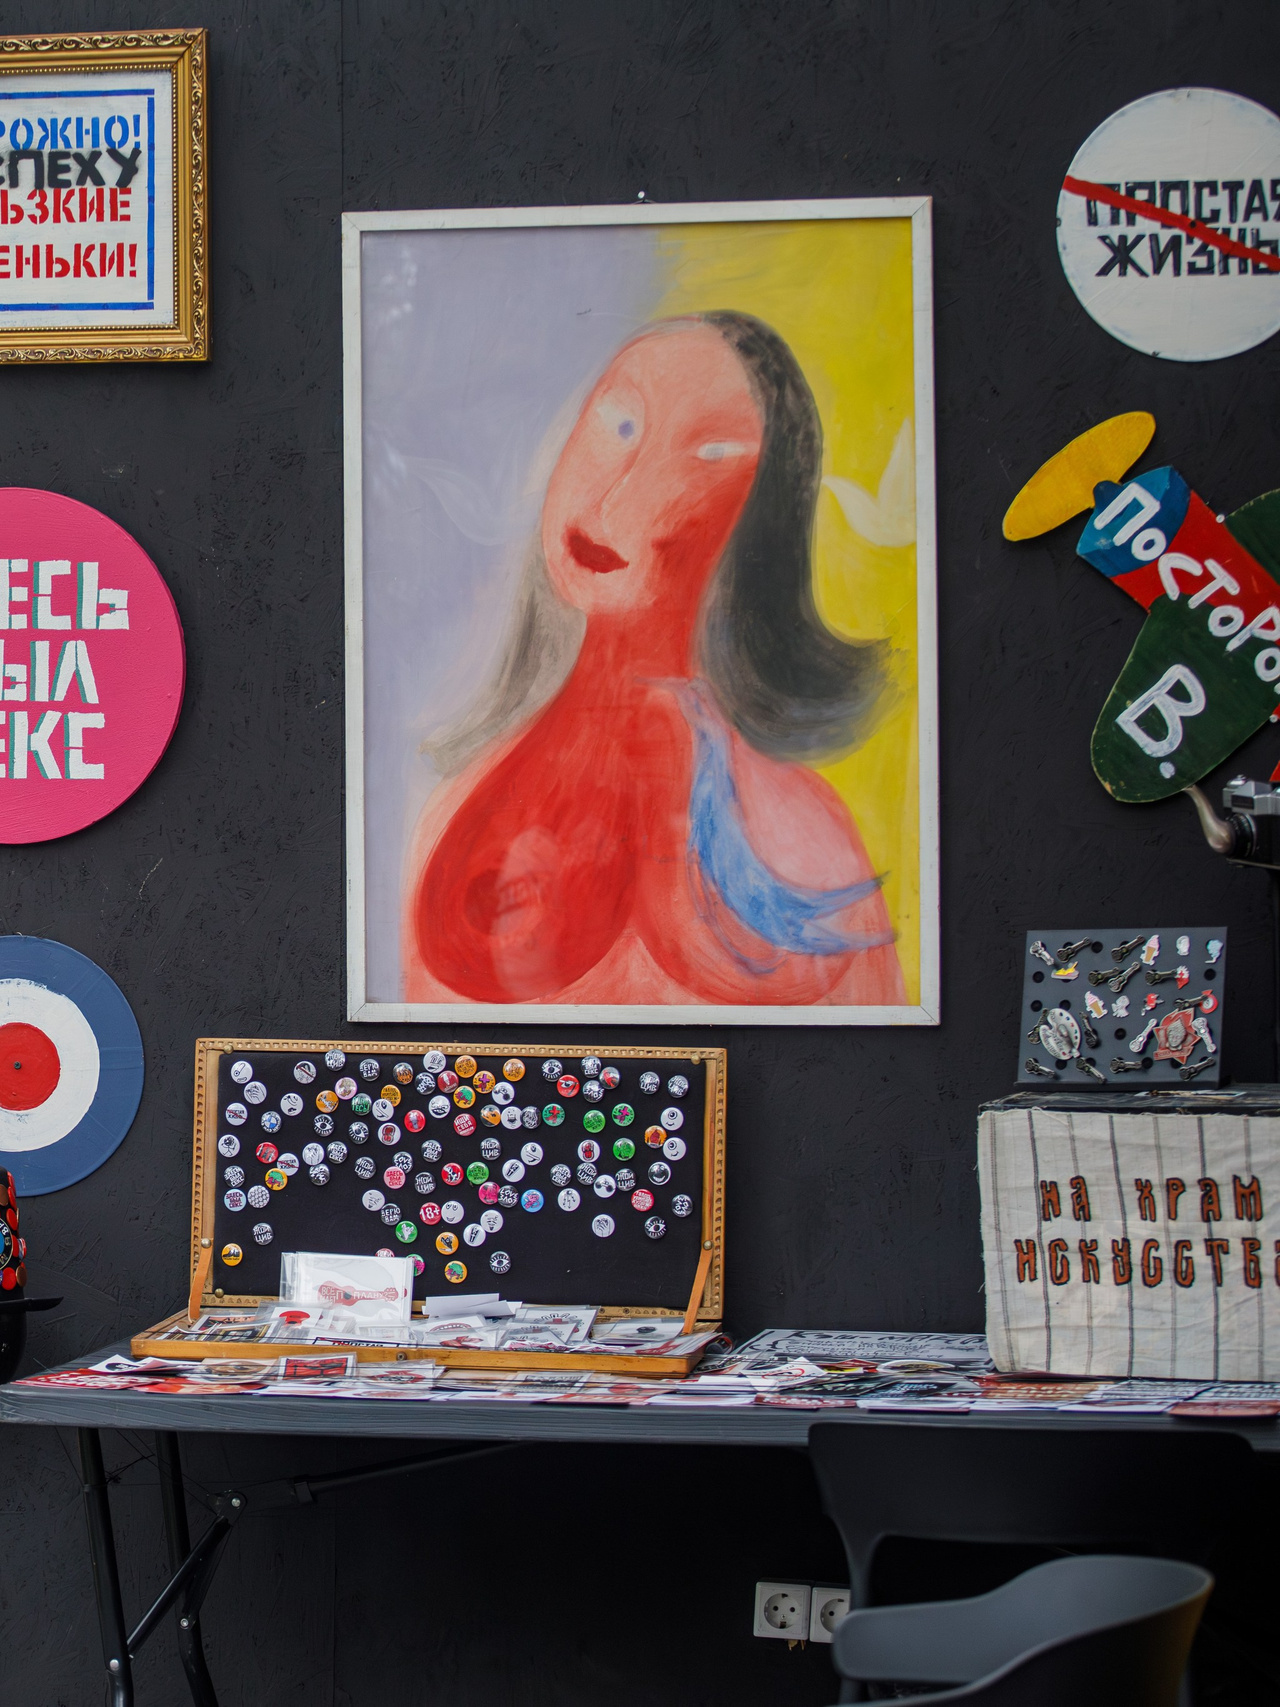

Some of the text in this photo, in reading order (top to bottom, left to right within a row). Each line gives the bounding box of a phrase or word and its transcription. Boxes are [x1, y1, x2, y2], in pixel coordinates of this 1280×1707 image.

[420, 1207, 439, 1220] 18+
[1040, 1175, 1263, 1222] НА ХРАМ
[1014, 1237, 1280, 1289] ИСКУССТВ
